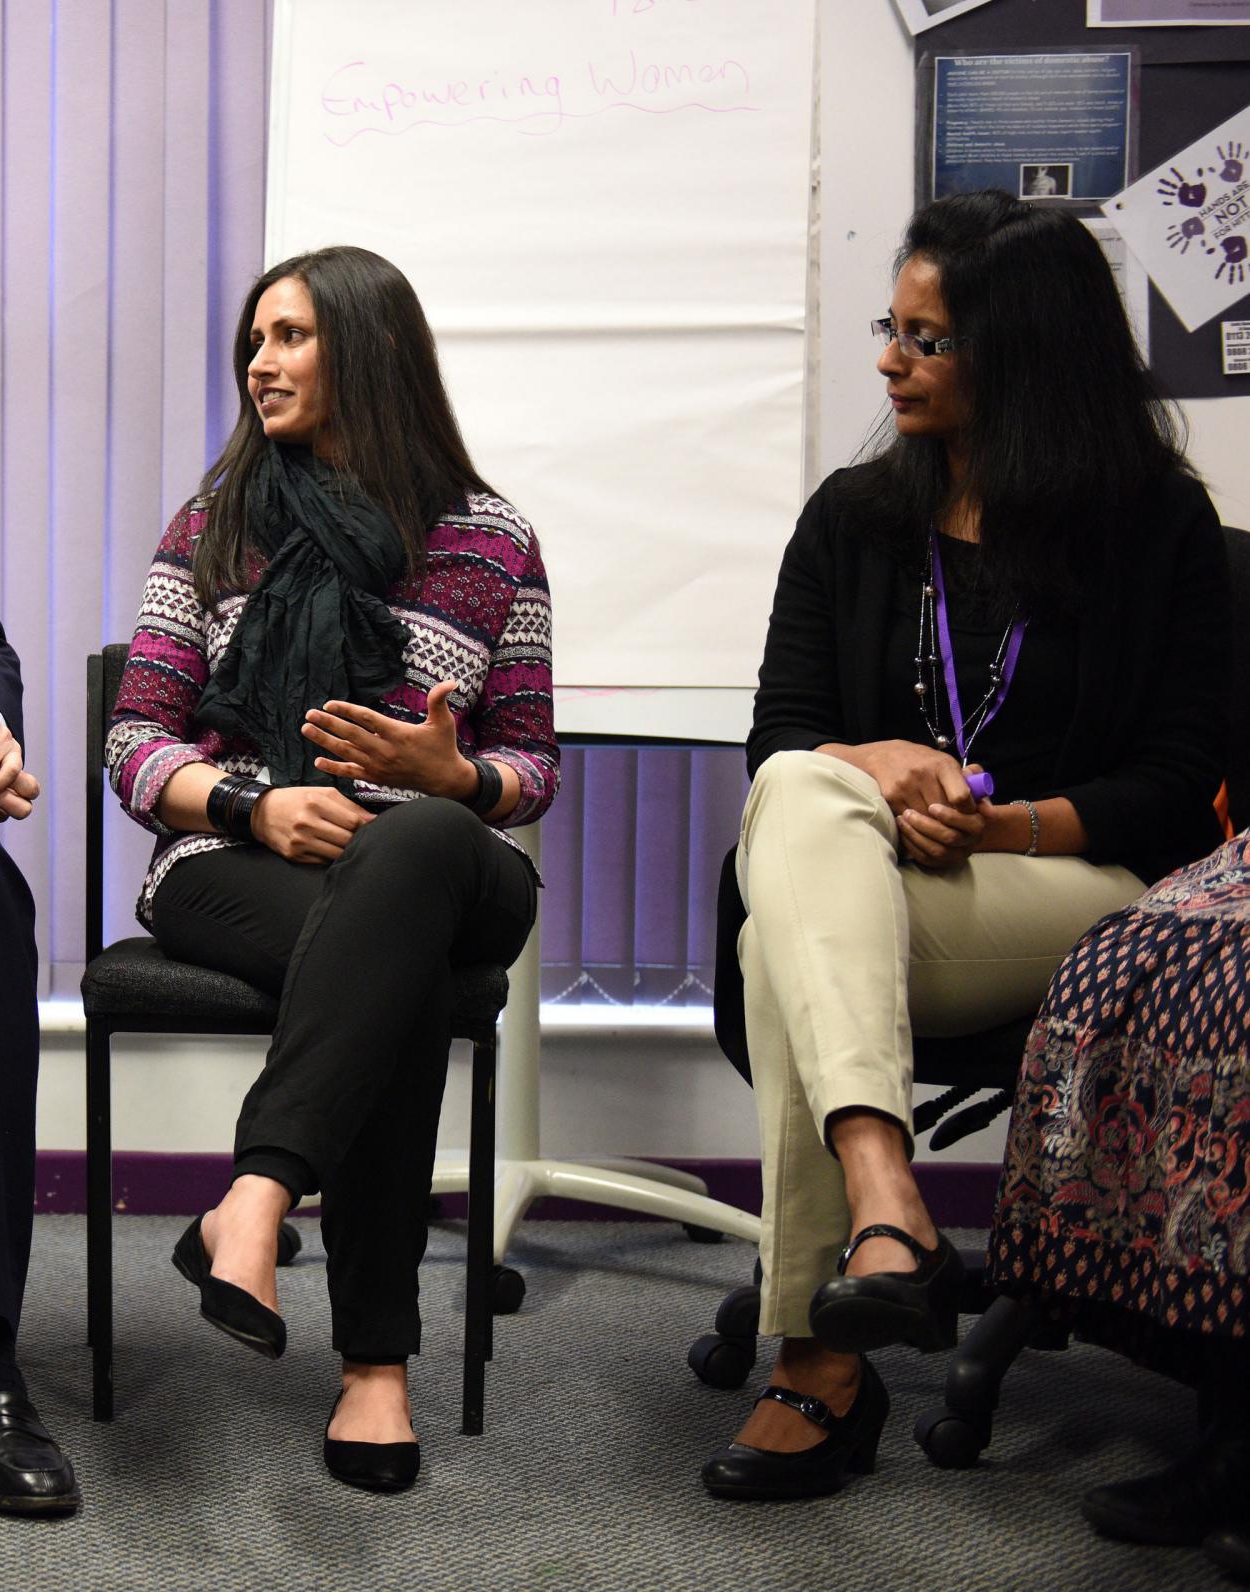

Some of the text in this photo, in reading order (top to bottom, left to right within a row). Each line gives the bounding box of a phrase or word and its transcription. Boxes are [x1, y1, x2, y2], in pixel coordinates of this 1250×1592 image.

[954, 58, 974, 66] Who
[1033, 57, 1043, 65] of
[321, 60, 563, 136] Empowering
[1198, 180, 1250, 217] HANDS ARE
[1214, 195, 1247, 225] NOT
[1214, 225, 1232, 239] FOR
